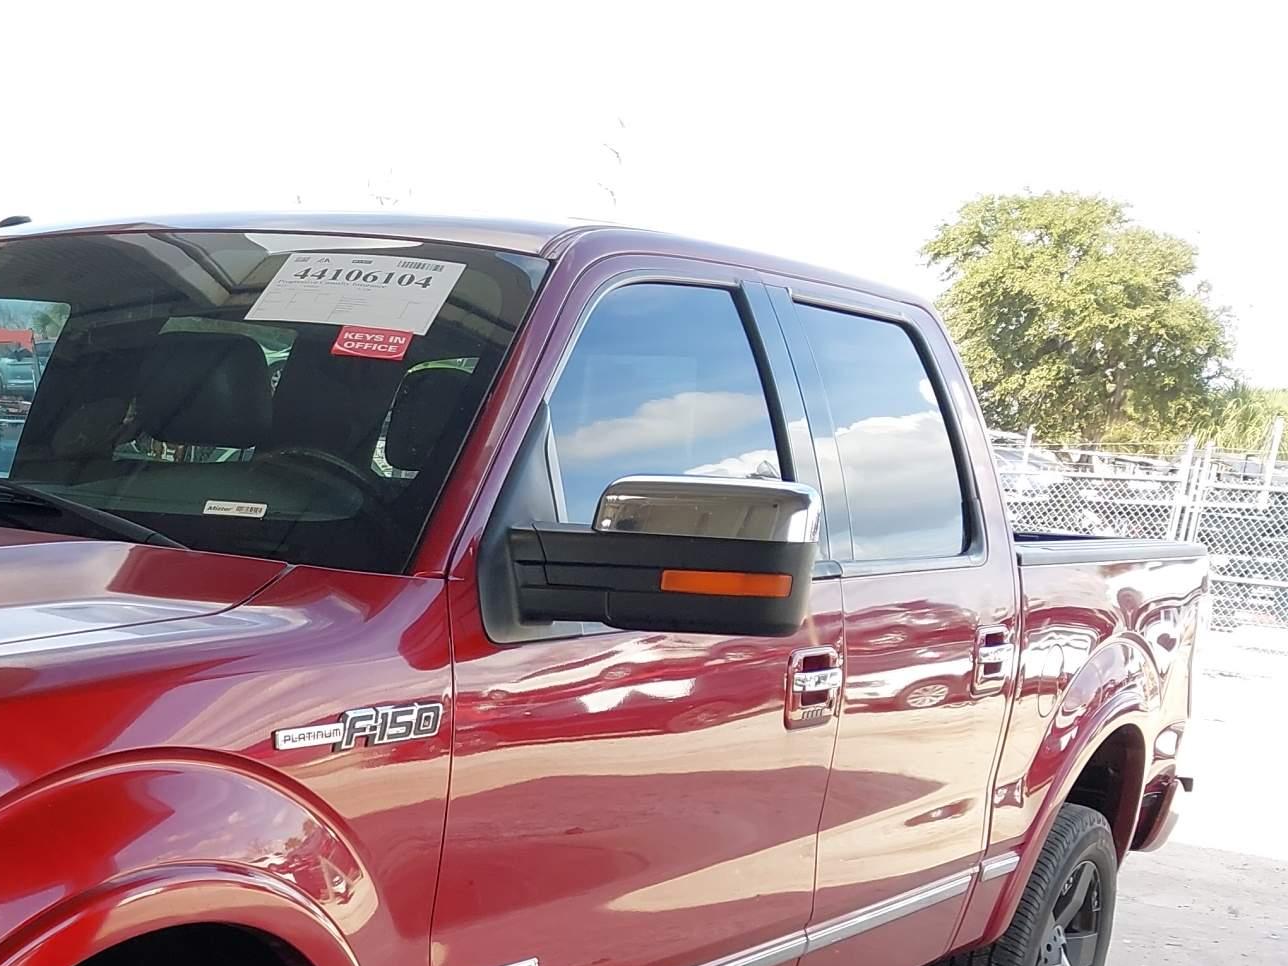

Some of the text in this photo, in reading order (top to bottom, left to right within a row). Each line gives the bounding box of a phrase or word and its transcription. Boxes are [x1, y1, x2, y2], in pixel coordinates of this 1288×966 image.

[295, 267, 433, 289] 44106104
[343, 332, 406, 345] KEYS IN
[343, 341, 398, 353] OFFICE
[283, 727, 341, 744] PLATINUM
